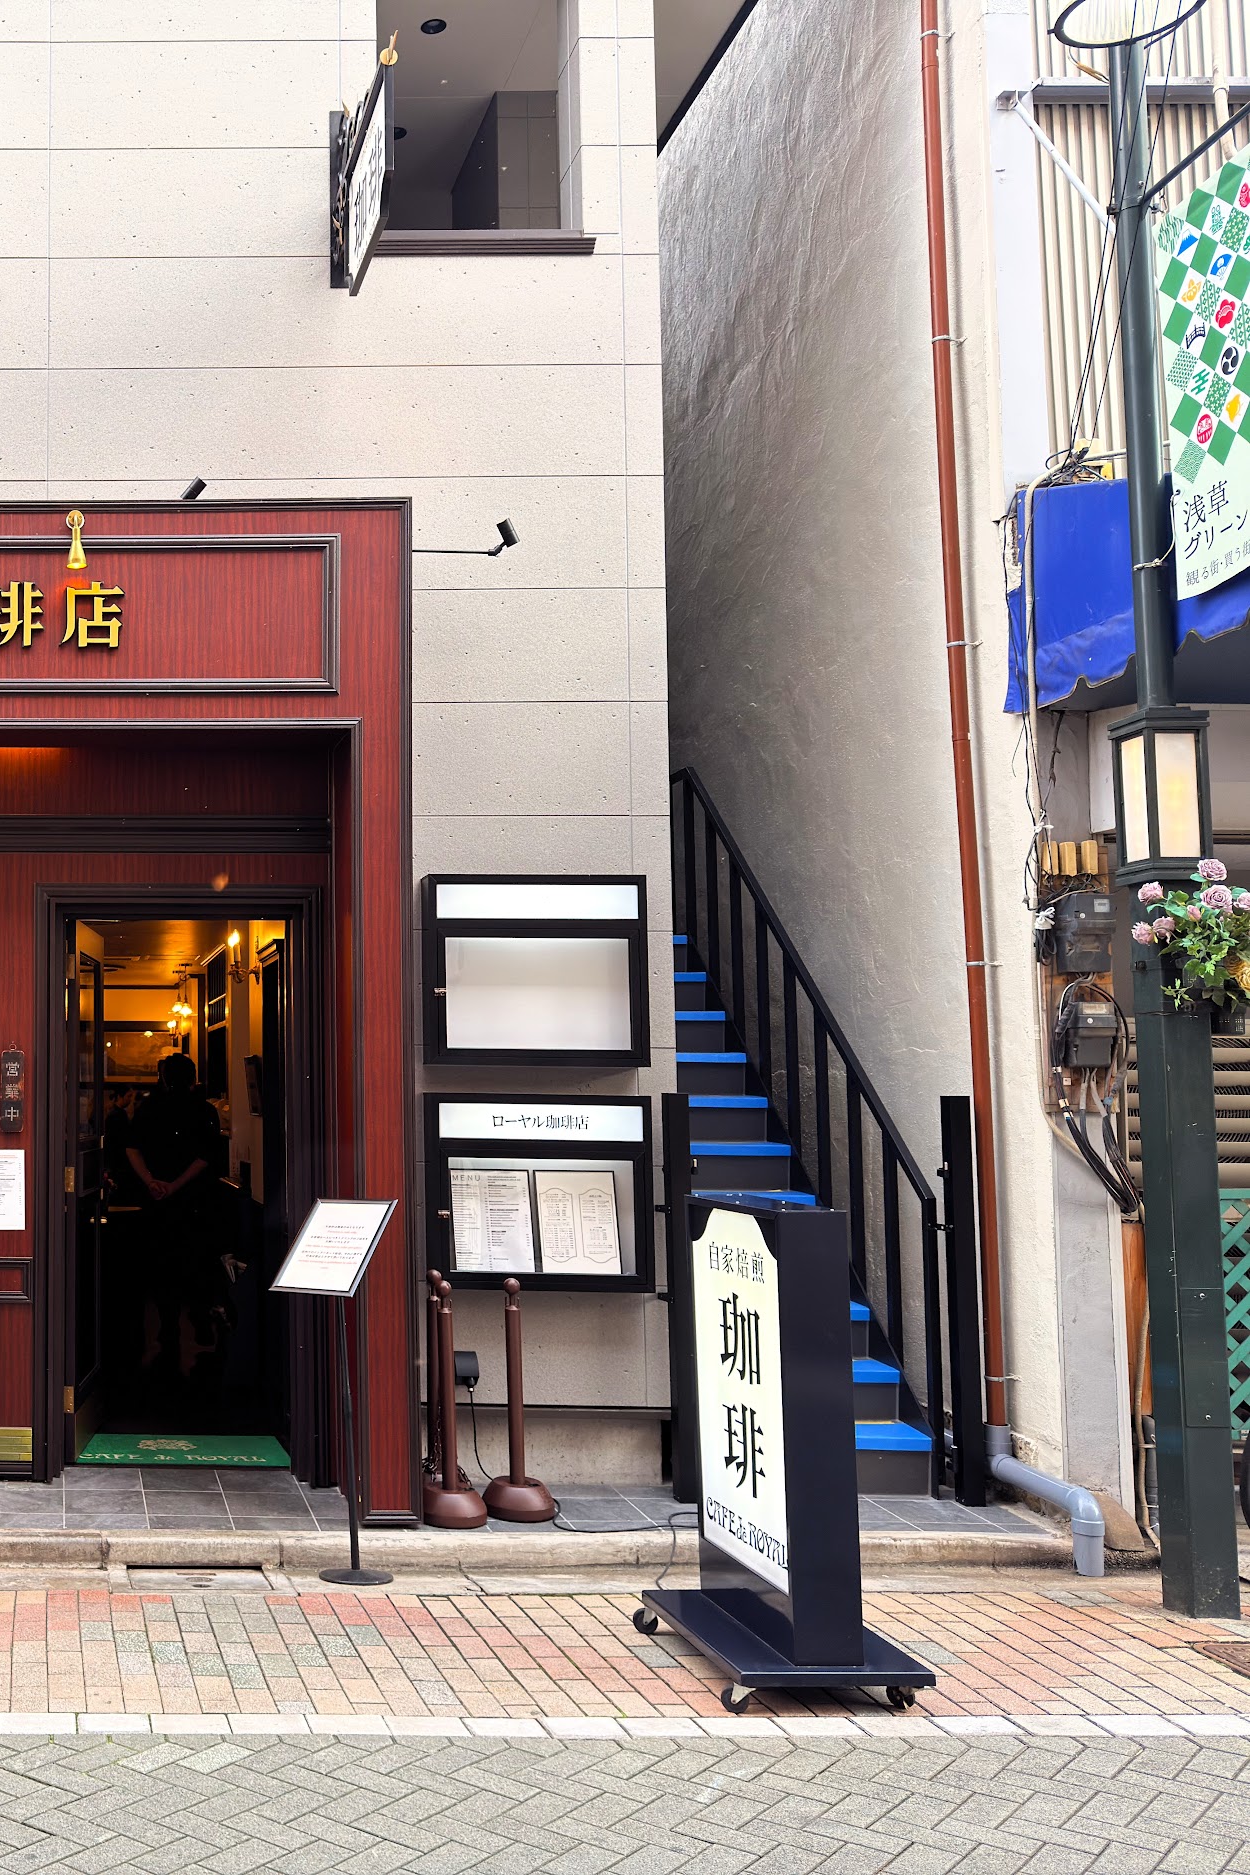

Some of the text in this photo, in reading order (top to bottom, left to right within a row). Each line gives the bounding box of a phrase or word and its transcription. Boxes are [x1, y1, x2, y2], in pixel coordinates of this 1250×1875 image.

[1183, 480, 1229, 533] 浅草
[5, 1061, 20, 1122] 営業中
[492, 1114, 589, 1131] ローヤル珈琲店
[452, 1174, 481, 1182] MENU
[708, 1241, 765, 1284] 自家焙煎
[718, 1292, 766, 1498] 珈琲
